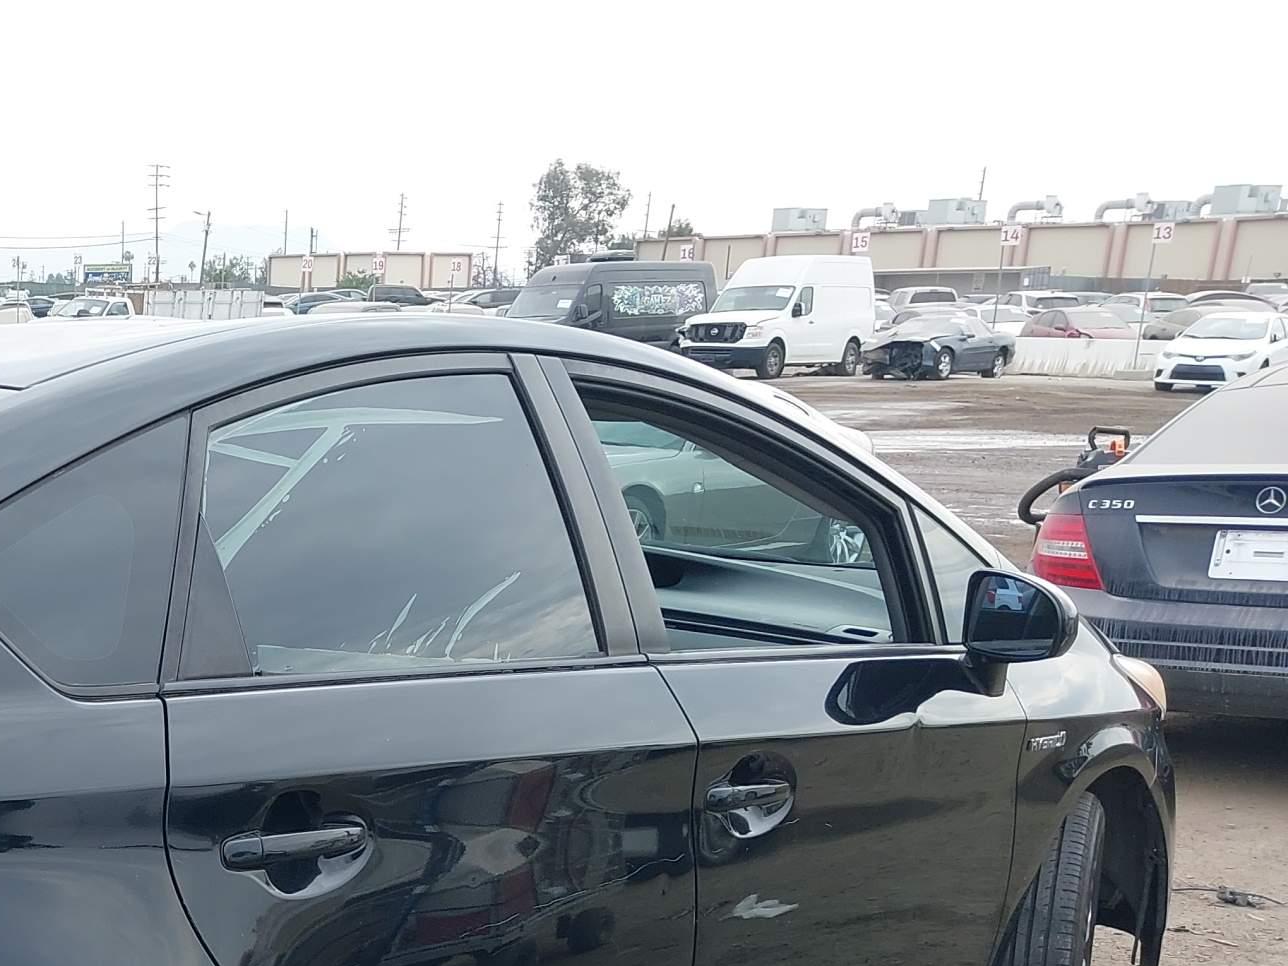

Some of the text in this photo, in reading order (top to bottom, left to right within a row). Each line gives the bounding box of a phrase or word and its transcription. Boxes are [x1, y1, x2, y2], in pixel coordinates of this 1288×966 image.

[1001, 230, 1019, 242] 14
[1153, 226, 1172, 240] 13
[853, 236, 868, 249] 15
[302, 259, 313, 269] 20
[373, 260, 384, 271] 19
[451, 261, 462, 272] 18
